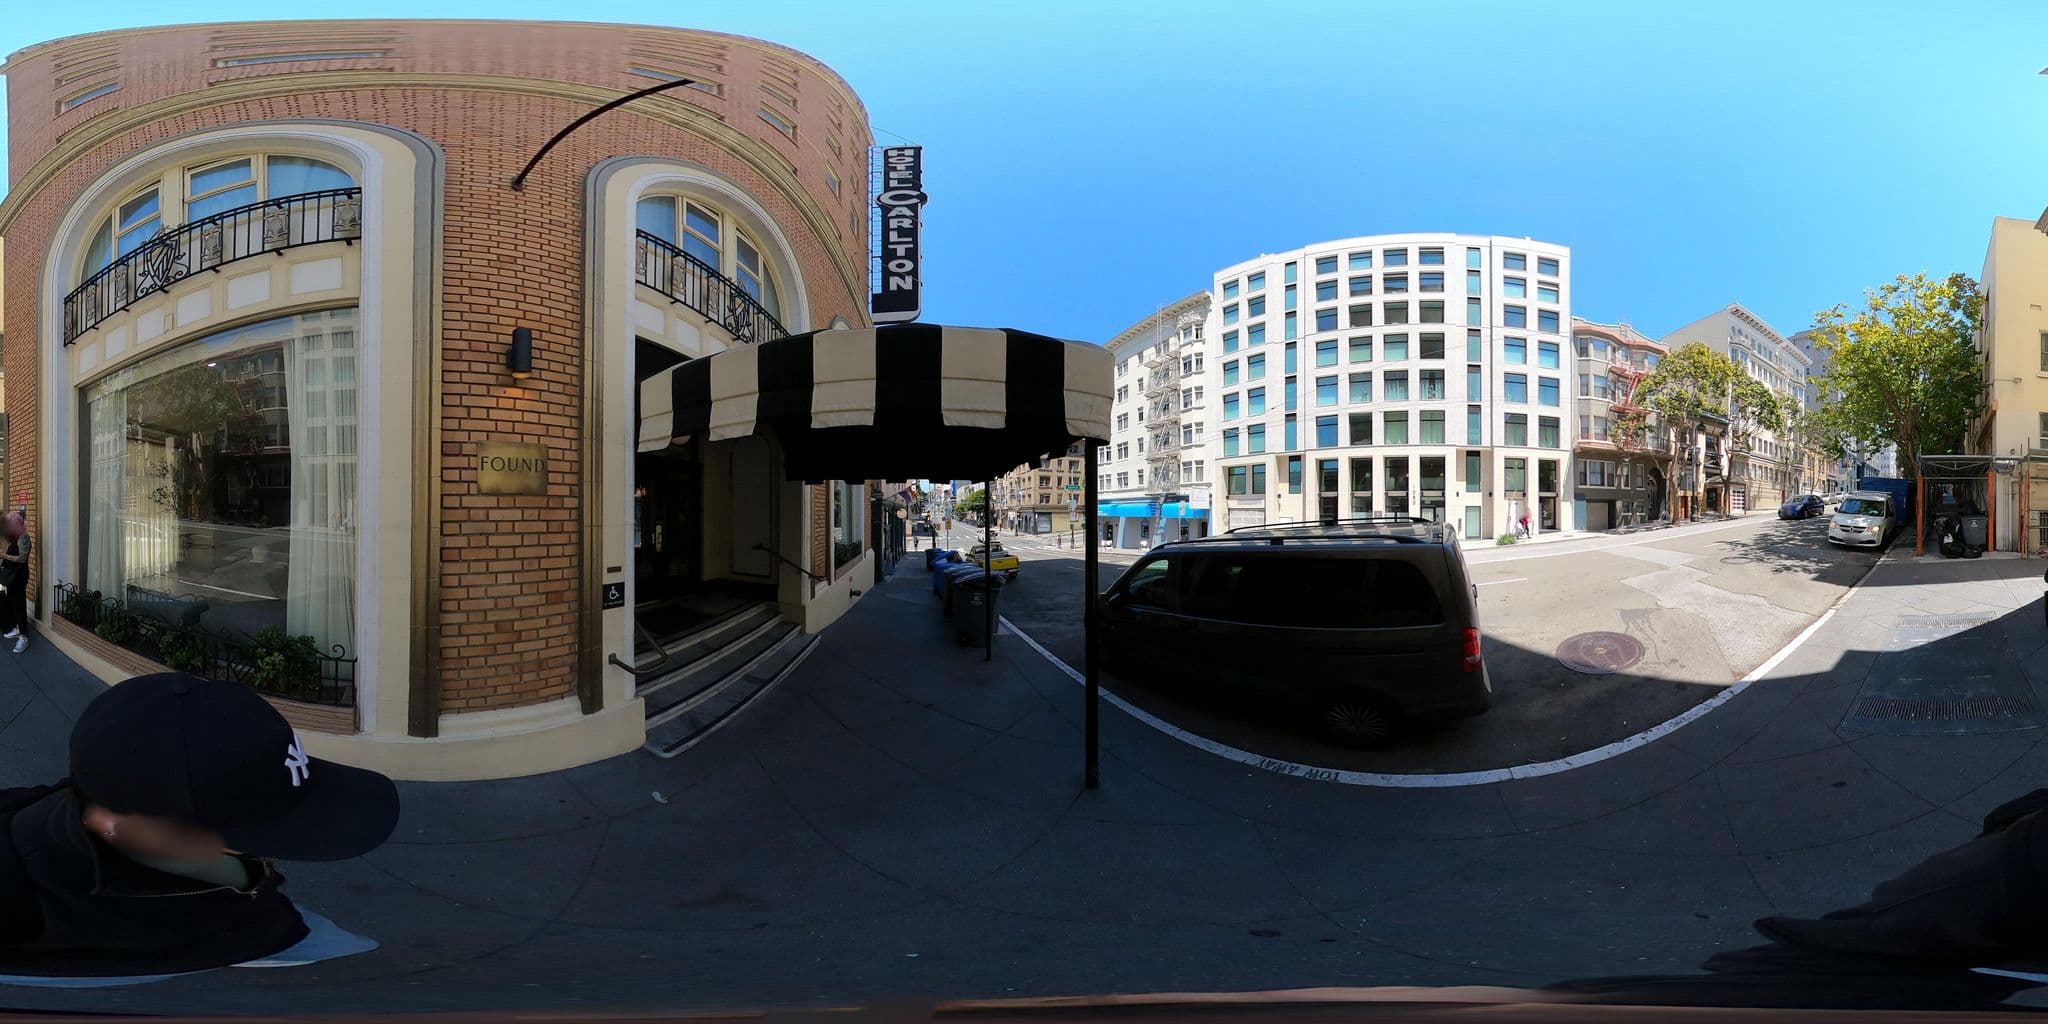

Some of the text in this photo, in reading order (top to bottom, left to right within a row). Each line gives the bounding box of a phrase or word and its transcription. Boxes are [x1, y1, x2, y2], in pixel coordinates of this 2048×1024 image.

[879, 148, 921, 292] HOTEL CARLTON
[480, 456, 545, 473] FOUND
[1305, 767, 1341, 781] TOW
